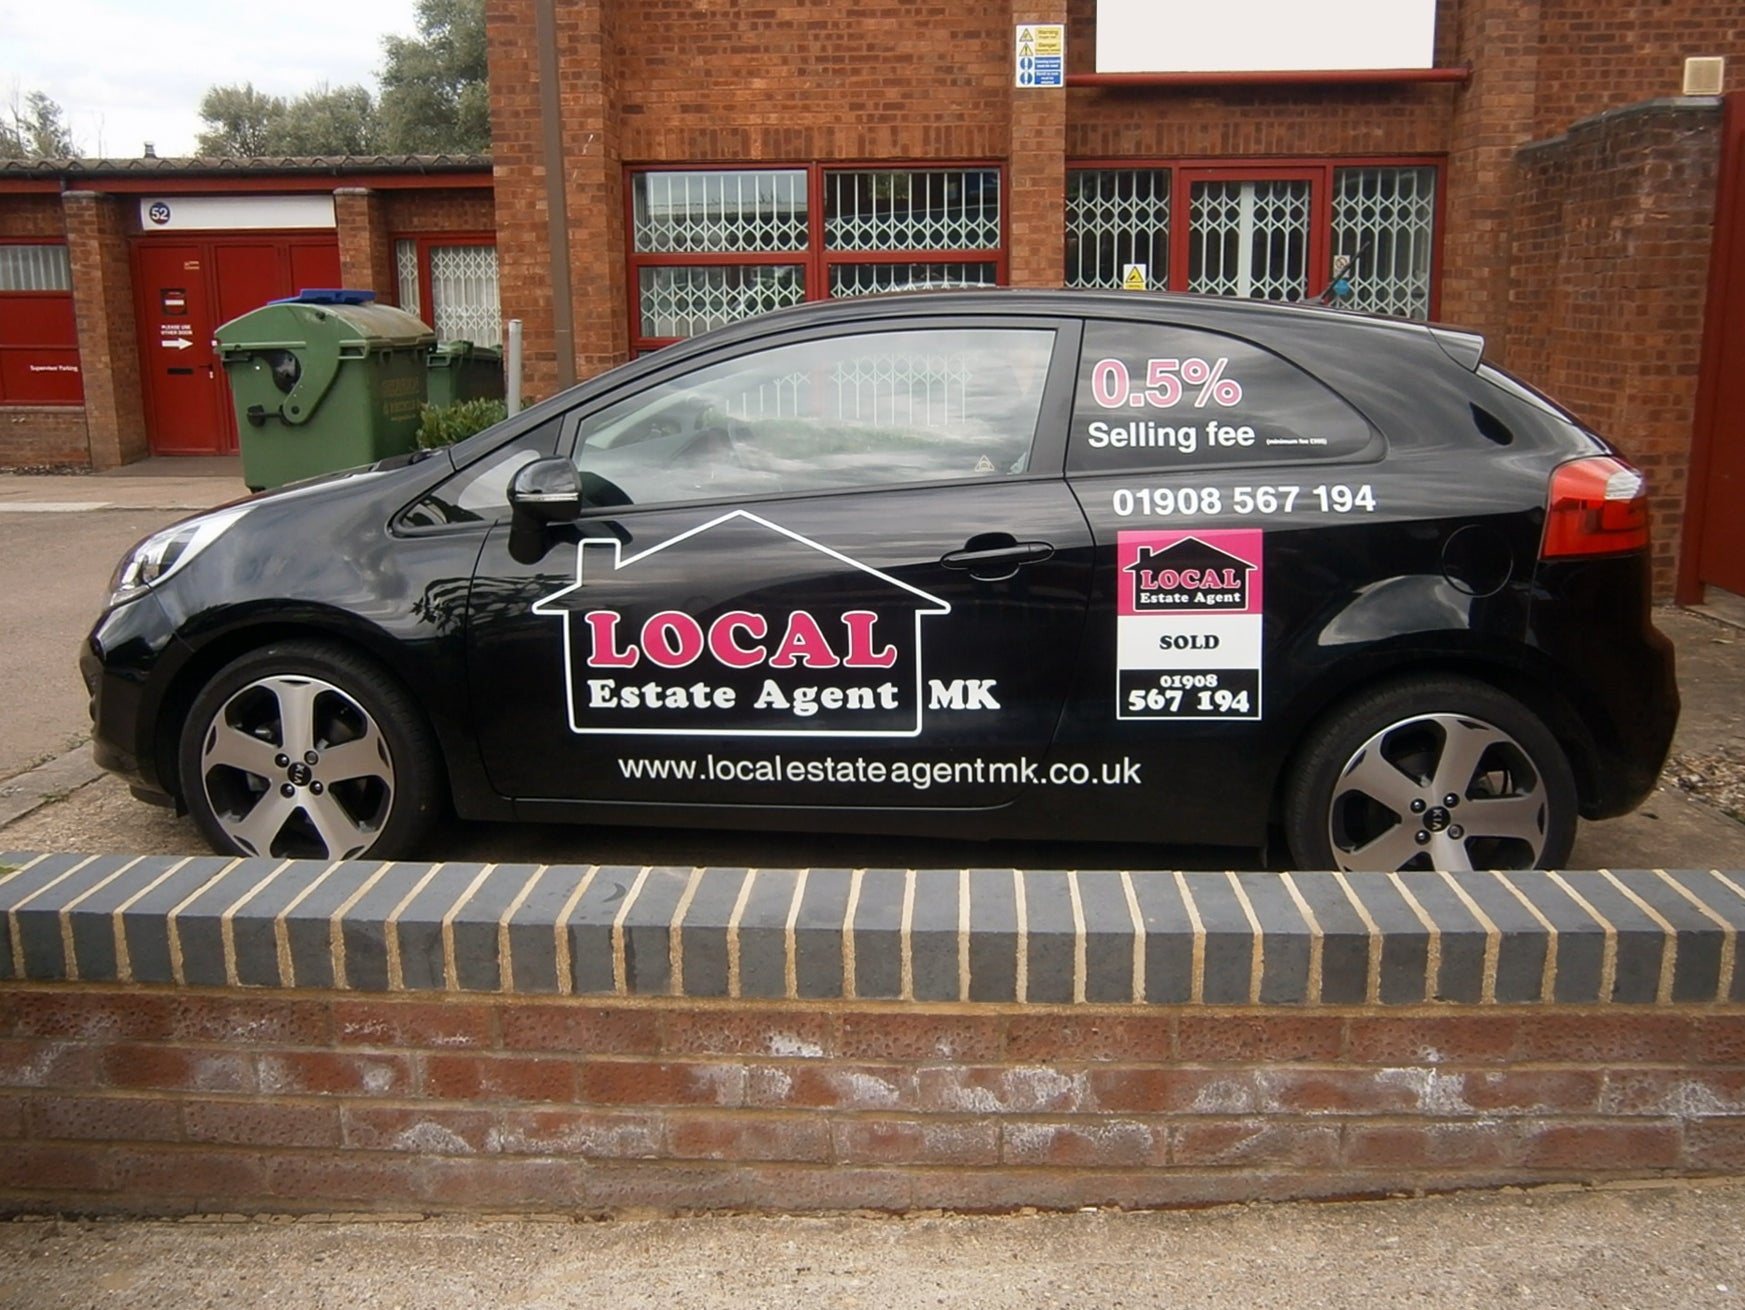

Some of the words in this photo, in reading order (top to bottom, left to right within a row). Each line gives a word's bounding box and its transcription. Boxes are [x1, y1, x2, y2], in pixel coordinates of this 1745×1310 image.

[151, 207, 169, 220] 52
[1092, 357, 1242, 408] 0.5%
[1088, 422, 1196, 453] Selling
[1205, 421, 1256, 447] fee
[1113, 487, 1222, 516] 01908
[1233, 486, 1300, 514] 567
[1312, 485, 1377, 512] 194
[1140, 568, 1241, 590] LOCAL
[1140, 592, 1189, 604] Estate
[1194, 591, 1241, 605] Agent
[584, 610, 898, 669] LOCAL
[1159, 635, 1220, 650] SOLD
[1160, 674, 1218, 689] 01908
[587, 679, 737, 709] Estate
[754, 678, 899, 716] Agent
[928, 679, 1001, 710] MK
[1128, 688, 1183, 712] 567
[1197, 689, 1250, 713] 194
[618, 754, 1142, 790] www.localestateagentmk.co.uk
